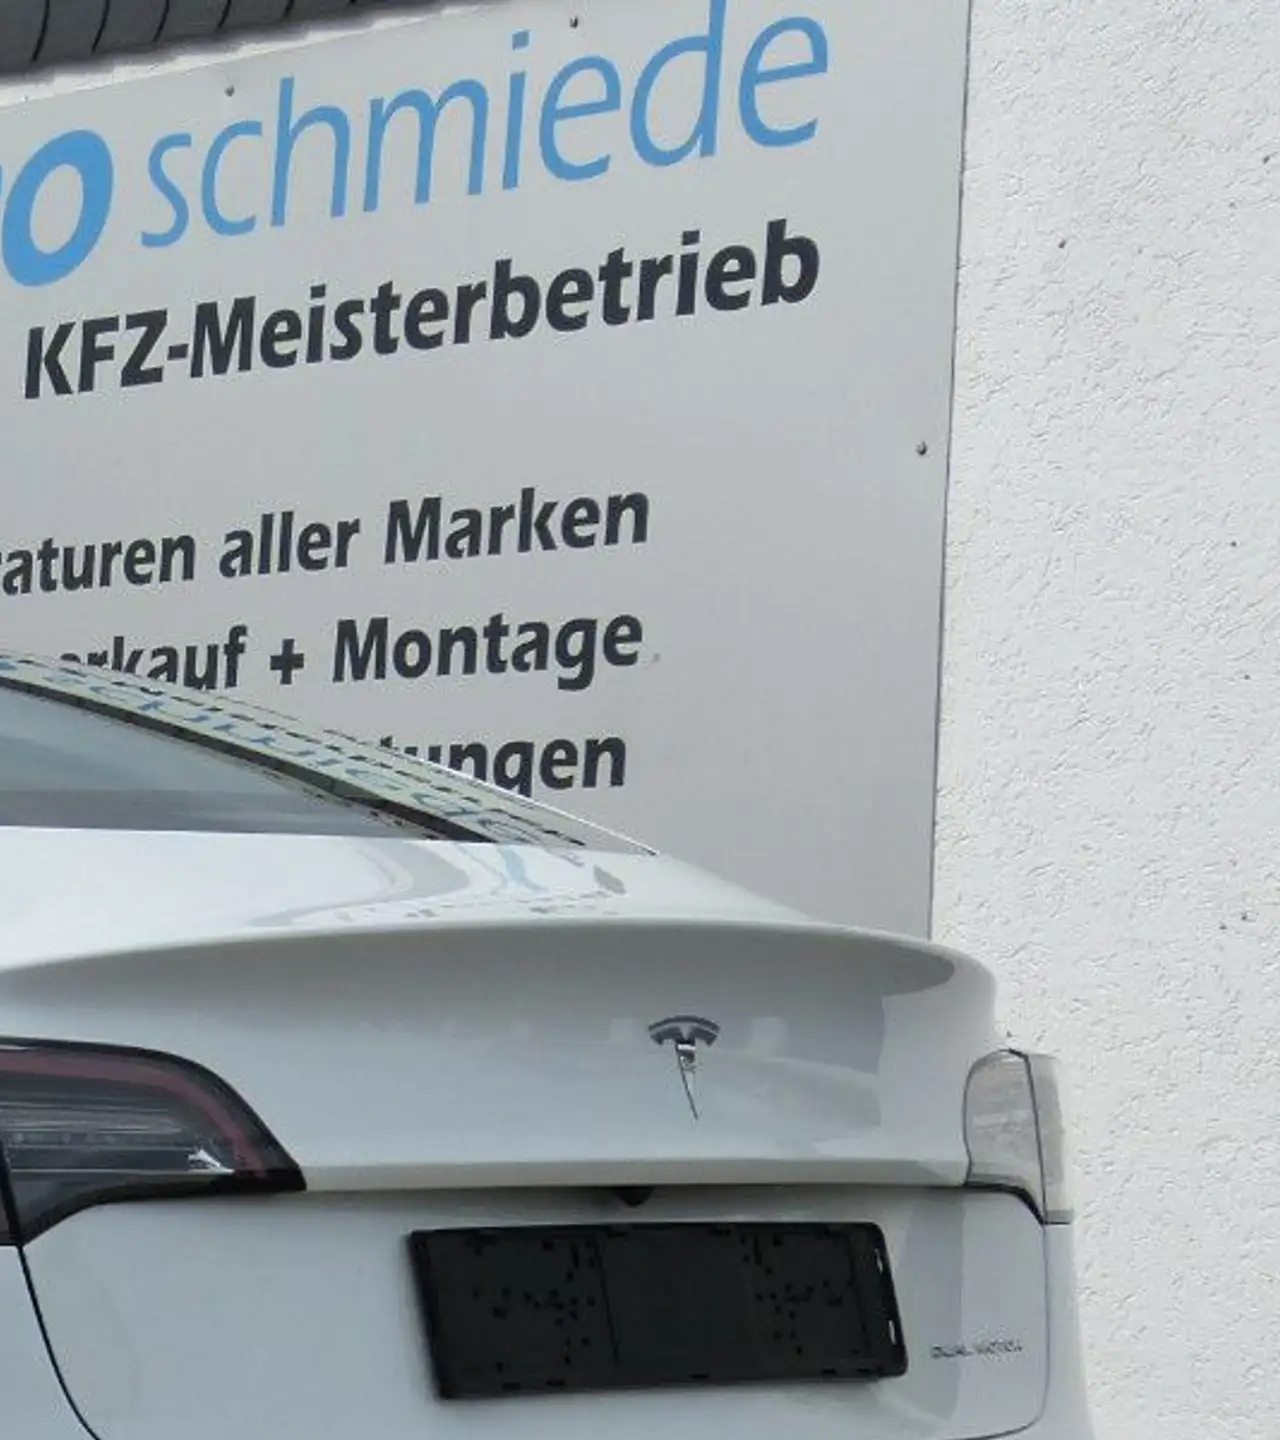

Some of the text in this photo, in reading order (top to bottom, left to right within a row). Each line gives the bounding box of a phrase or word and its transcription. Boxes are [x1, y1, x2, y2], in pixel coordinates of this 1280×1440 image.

[23, 218, 821, 400] KFZ-Meisterbetrieb
[219, 510, 362, 584] aller
[383, 487, 650, 565] Marken
[269, 638, 305, 686] +
[331, 613, 644, 692] Montage
